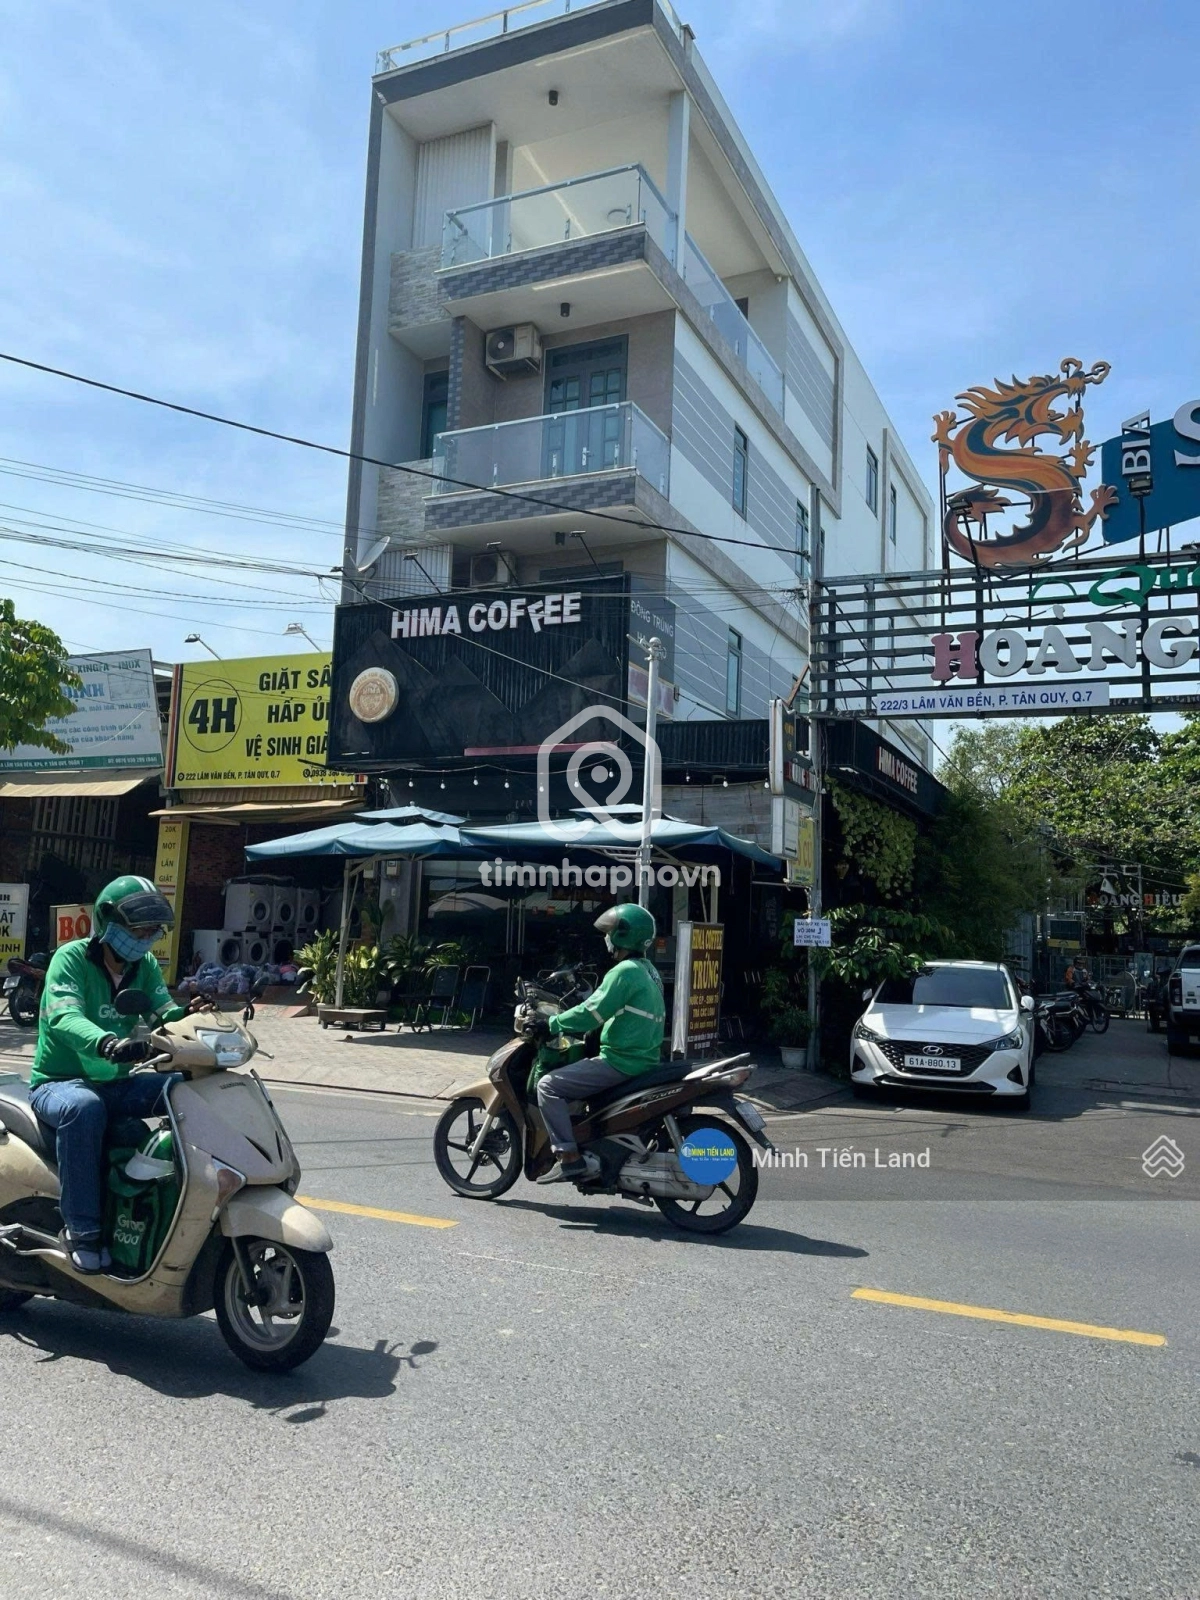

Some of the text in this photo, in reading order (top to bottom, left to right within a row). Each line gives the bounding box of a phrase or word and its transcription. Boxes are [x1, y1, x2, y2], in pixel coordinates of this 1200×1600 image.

[1121, 409, 1150, 475] BIA
[391, 592, 581, 639] HIMA COFFEE
[931, 603, 1198, 681] HOÀNG
[259, 667, 301, 694] GIẶT
[188, 697, 237, 734] 4H
[267, 697, 306, 724] HẤP
[880, 699, 908, 711] 222/3
[912, 695, 936, 709] LÂM
[940, 695, 963, 708] VĂN
[999, 693, 1007, 706] P.
[1013, 690, 1036, 704] TÂN
[1040, 691, 1069, 705] QUY,
[1072, 690, 1093, 703] Q.7
[246, 734, 262, 761] VỆ
[267, 736, 301, 756] SINH
[185, 772, 197, 780] 222
[197, 771, 209, 780] LÂM
[58, 907, 92, 941] BÒ
